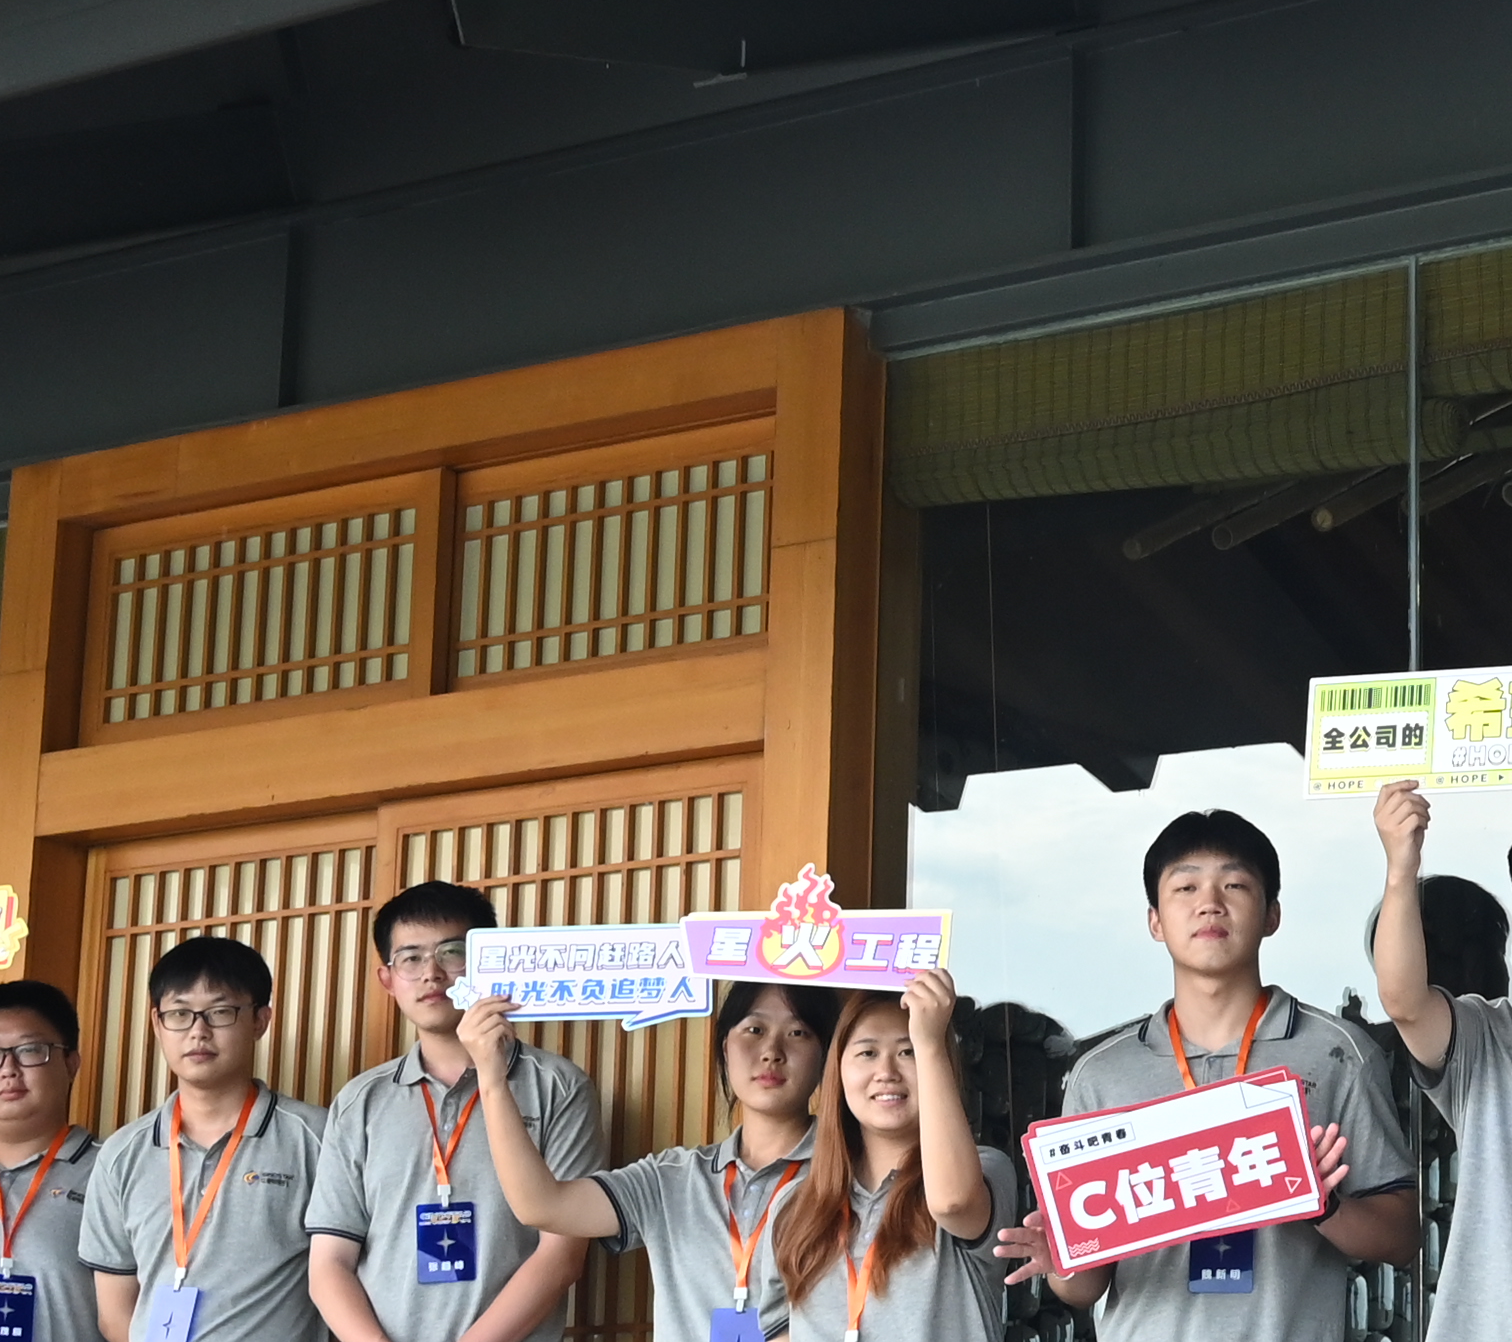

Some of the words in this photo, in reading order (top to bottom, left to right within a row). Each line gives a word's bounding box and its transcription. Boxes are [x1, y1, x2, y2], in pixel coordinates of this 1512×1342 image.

[1322, 722, 1425, 752] 全公司的
[1327, 780, 1365, 790] HOPE
[1450, 774, 1488, 784] HOPE
[478, 940, 686, 973] 星光不问赶路人
[706, 922, 942, 975] 星火工程
[490, 976, 696, 1006] 时光不负追梦人
[1048, 1128, 1127, 1158] #奋斗吧青春
[1069, 1131, 1287, 1230] C位青年
